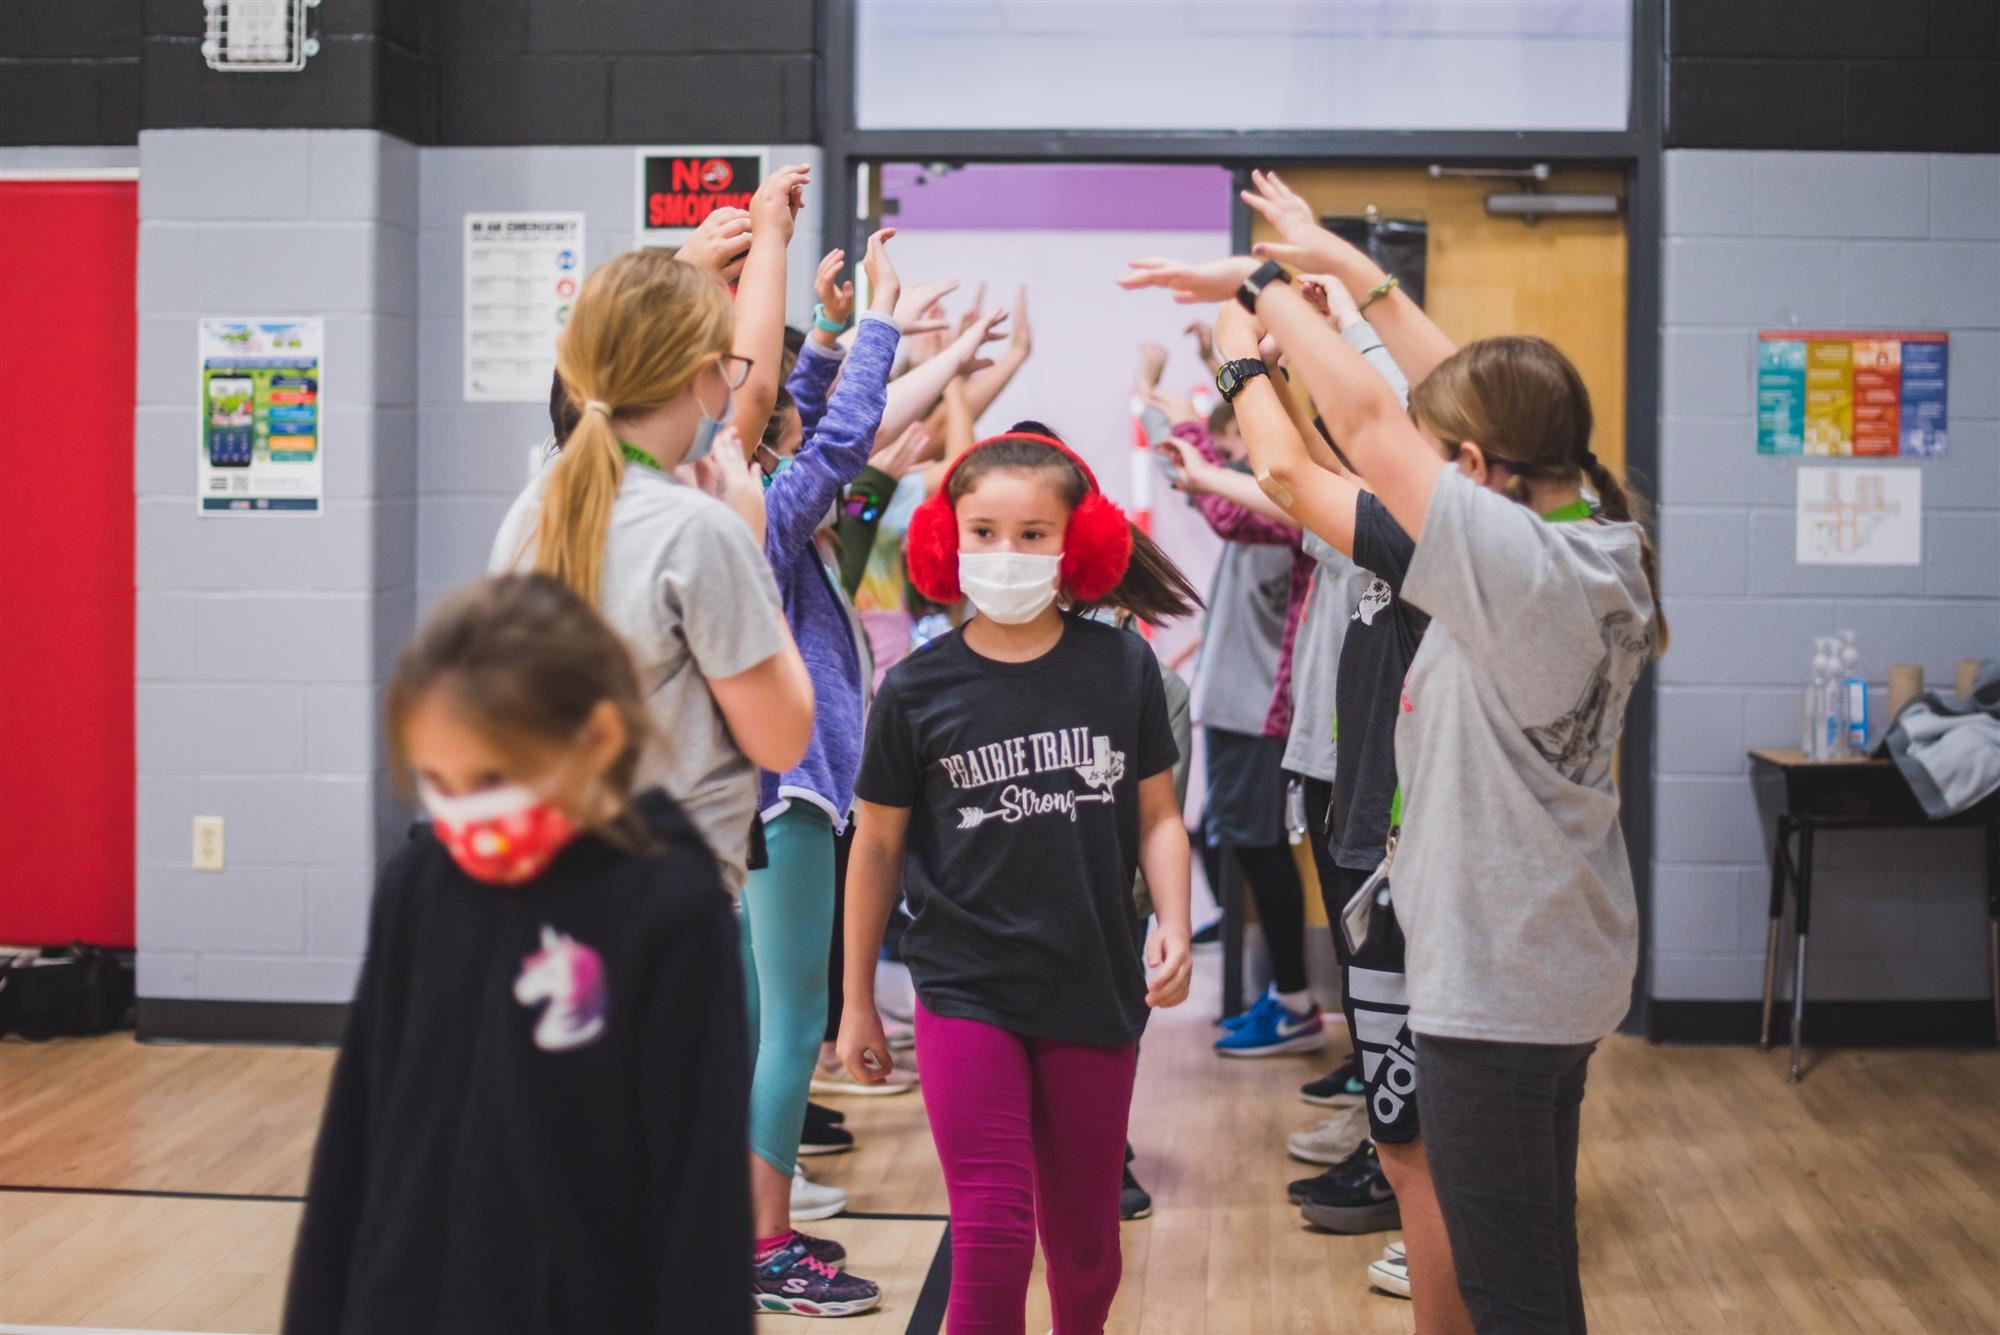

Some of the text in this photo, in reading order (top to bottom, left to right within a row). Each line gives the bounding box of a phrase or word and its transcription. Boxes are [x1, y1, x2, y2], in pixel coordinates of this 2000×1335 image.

[672, 158, 733, 191] NO
[939, 736, 1030, 788] PRAIRIE
[1028, 726, 1094, 774] TRAIL
[1000, 784, 1077, 823] Strong
